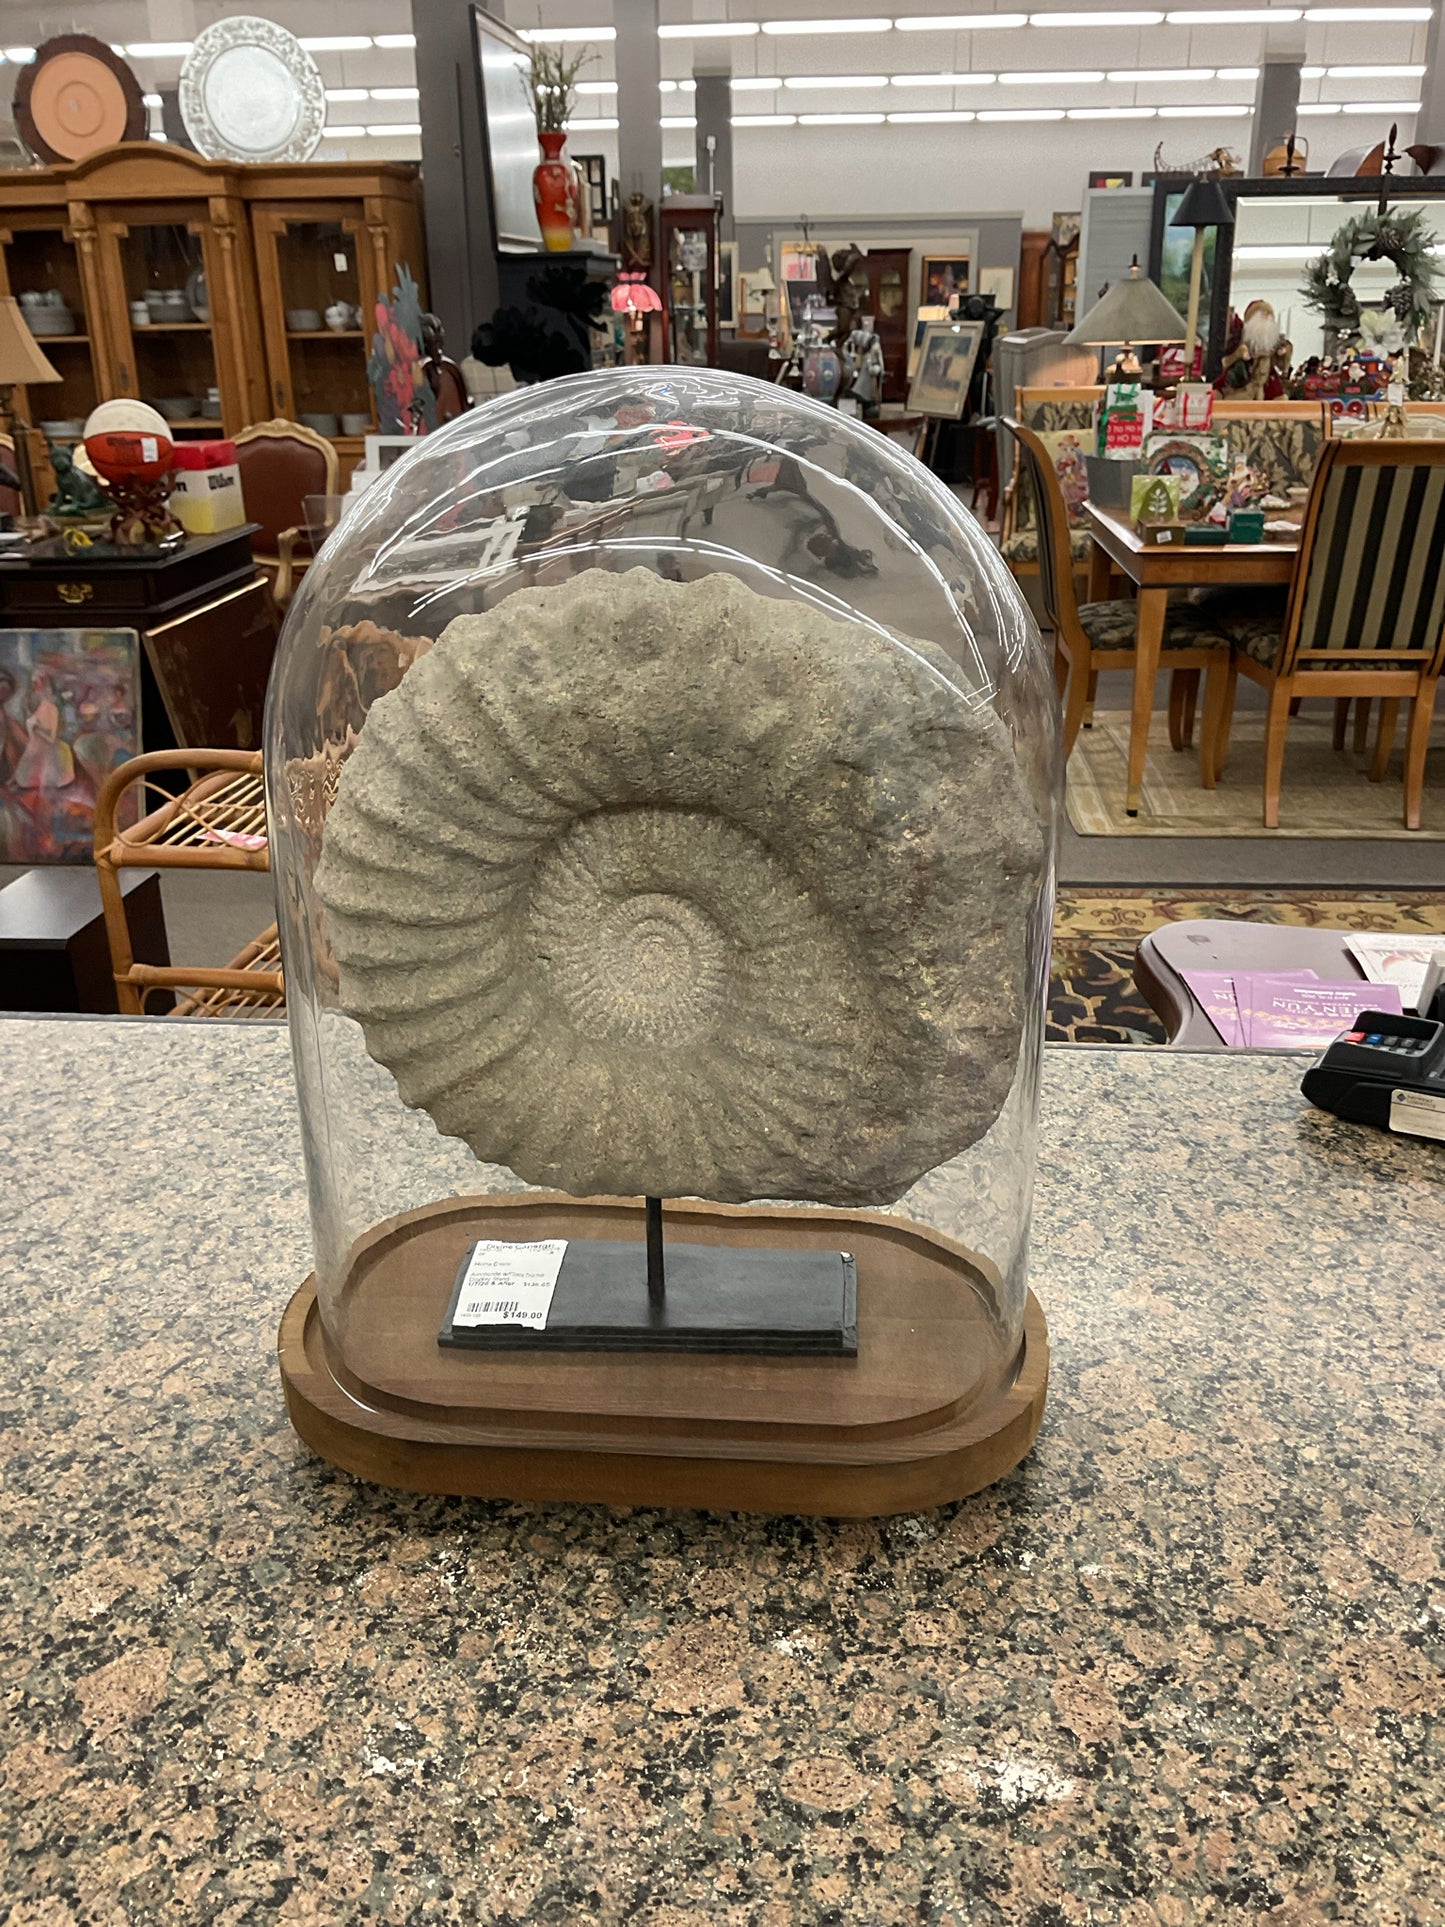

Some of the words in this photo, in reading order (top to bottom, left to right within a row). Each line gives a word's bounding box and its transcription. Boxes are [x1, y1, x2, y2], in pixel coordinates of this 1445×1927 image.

[207, 472, 235, 491] Wilson
[1272, 1000, 1316, 1013] YUN
[503, 1311, 543, 1319] $149.00
